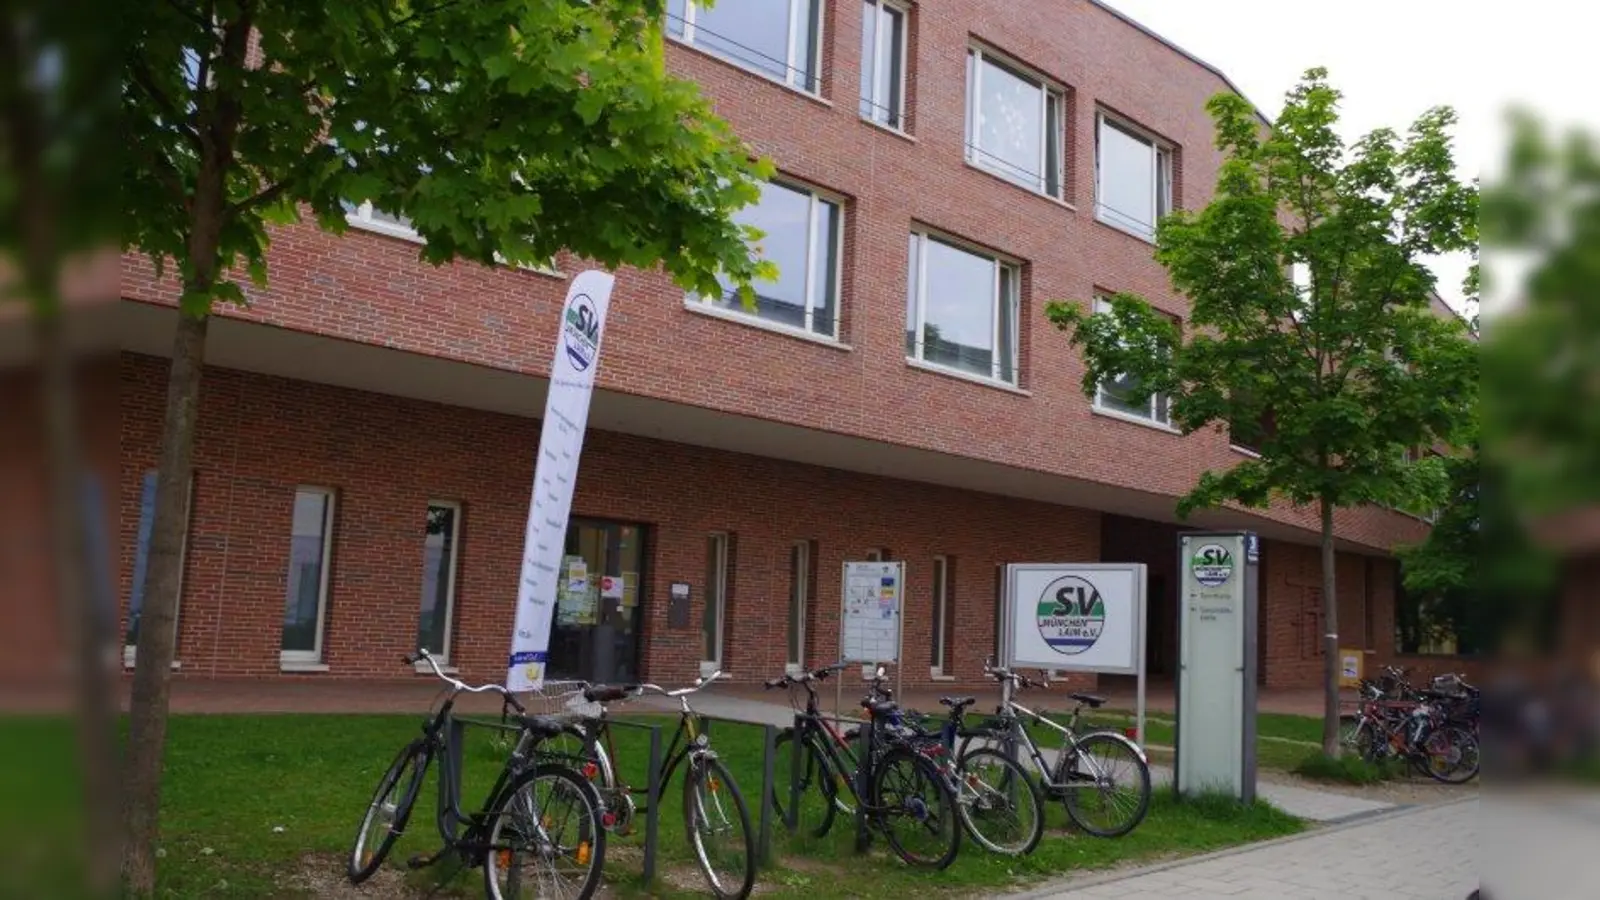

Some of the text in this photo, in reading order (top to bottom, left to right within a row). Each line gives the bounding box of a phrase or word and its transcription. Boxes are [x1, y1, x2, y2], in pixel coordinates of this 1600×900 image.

[575, 305, 598, 338] SV
[1203, 549, 1230, 566] SV
[1053, 586, 1099, 616] SV
[1042, 616, 1088, 628] MÜNCHEN
[1059, 627, 1082, 637] LAIM
